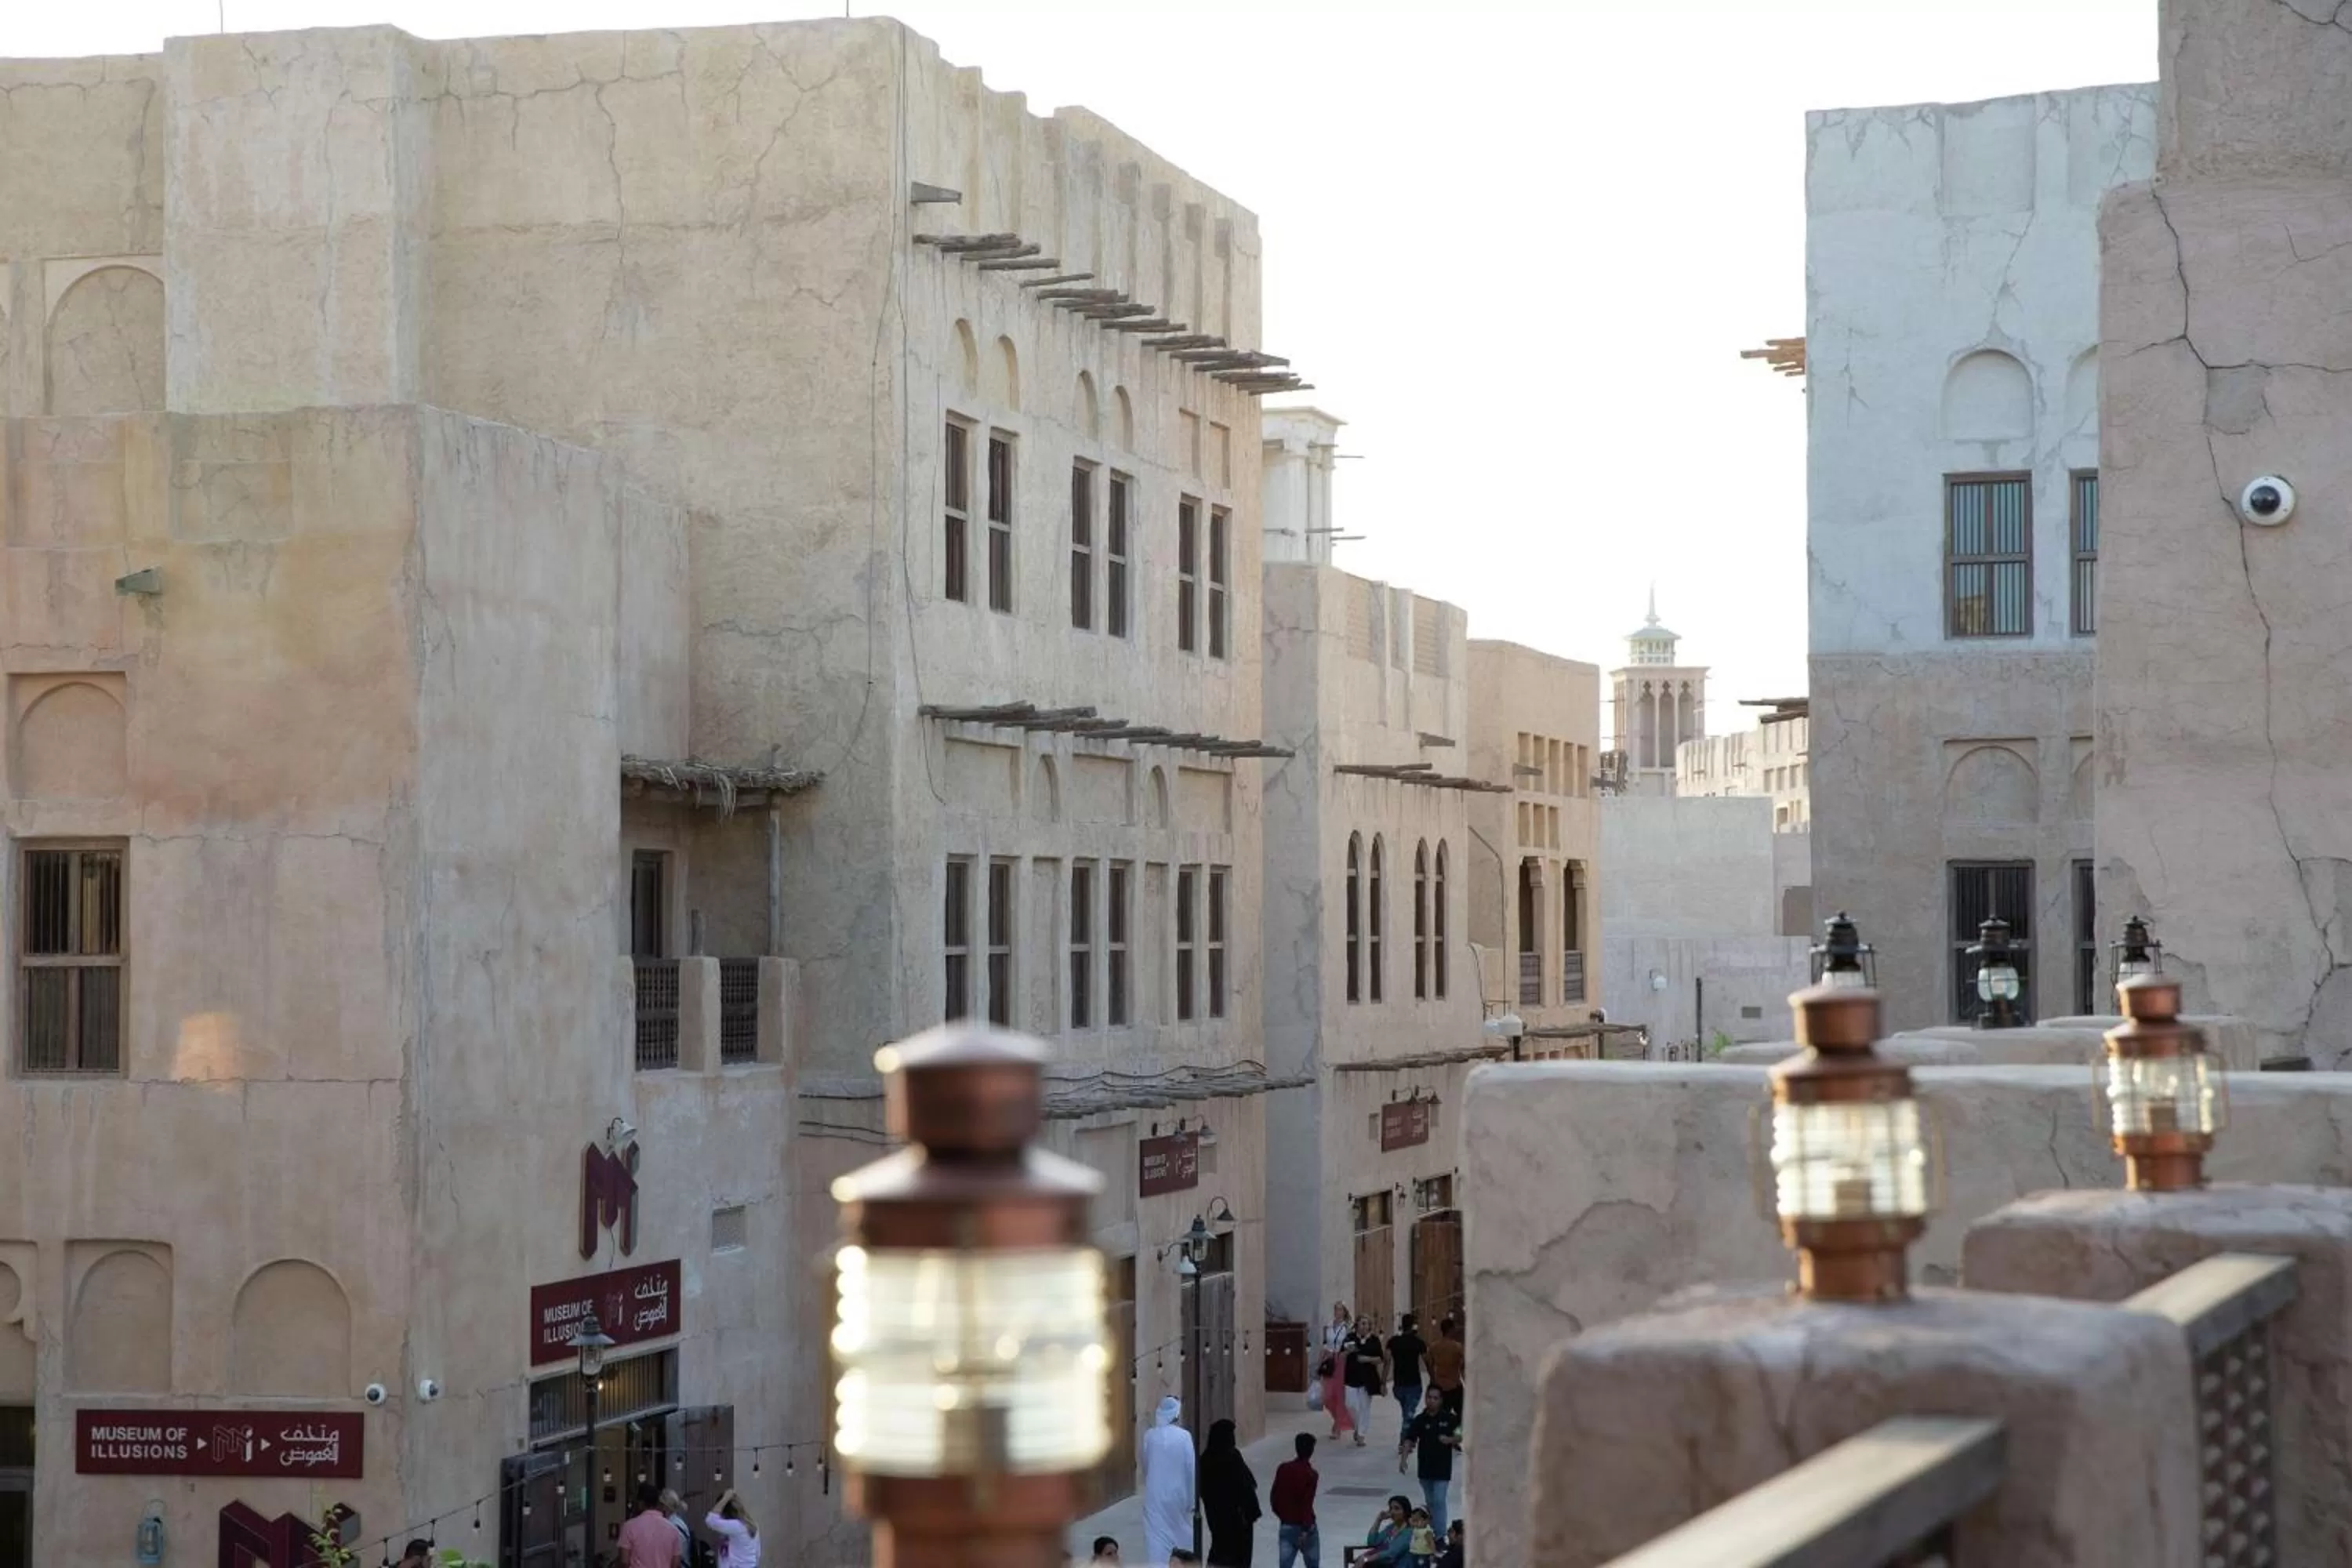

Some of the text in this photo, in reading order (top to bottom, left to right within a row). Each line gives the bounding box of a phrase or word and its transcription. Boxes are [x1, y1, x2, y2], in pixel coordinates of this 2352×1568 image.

[544, 1298, 593, 1324] MUSEUM OF
[543, 1321, 585, 1343] ILLUSIO
[91, 1426, 188, 1441] MUSEUM OF
[280, 1424, 339, 1445] متحف
[91, 1444, 188, 1459] ILLUSIONS
